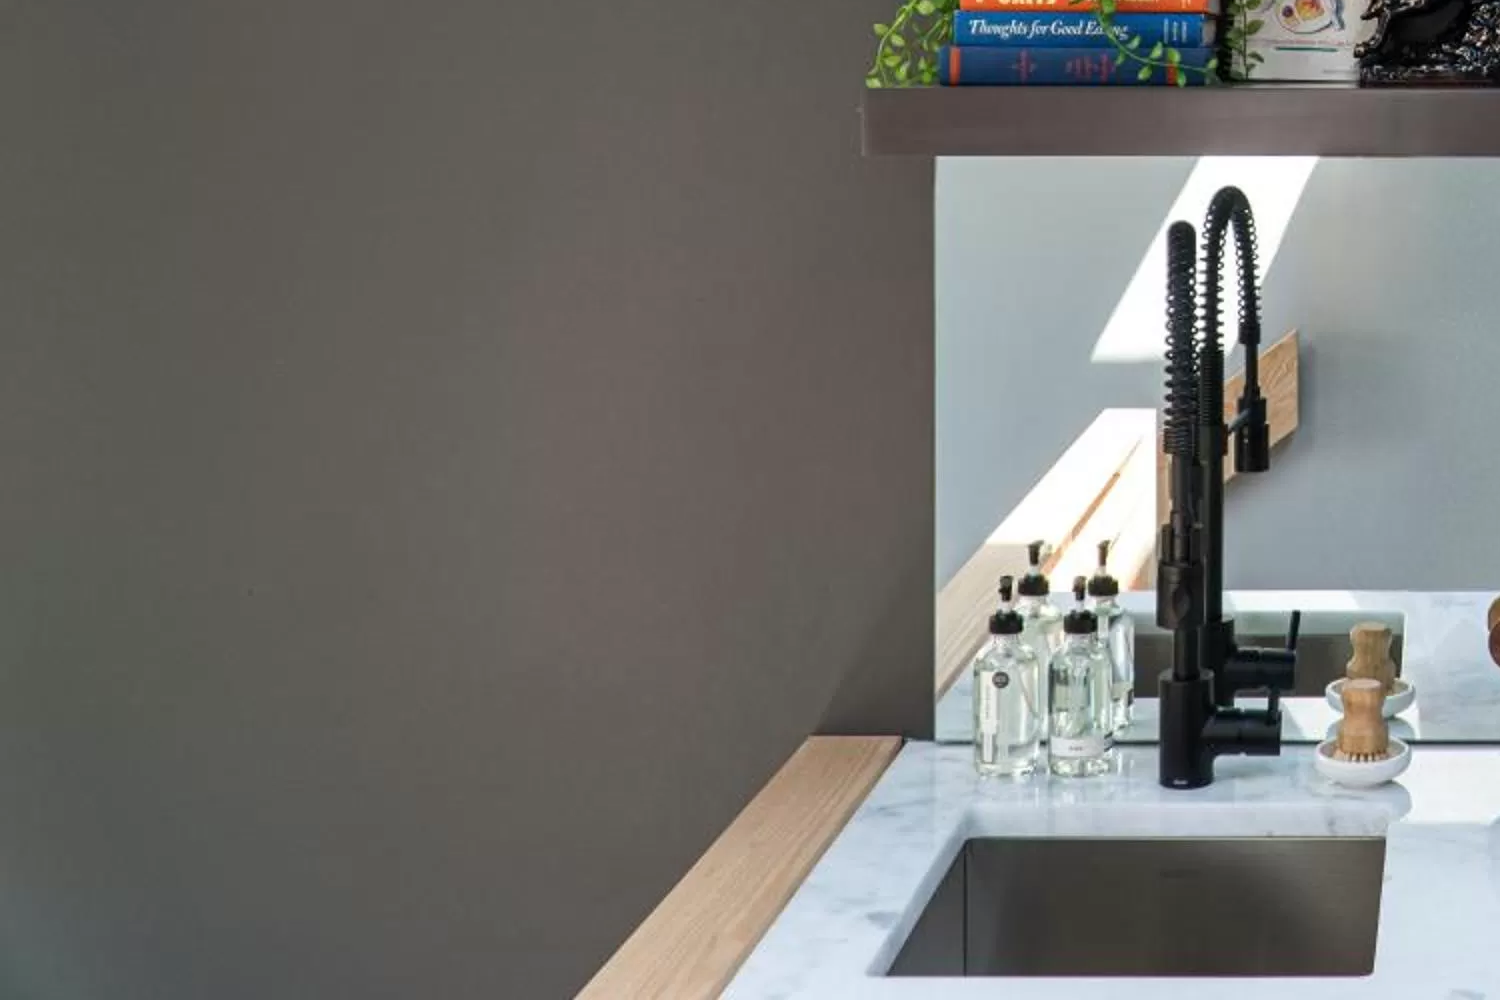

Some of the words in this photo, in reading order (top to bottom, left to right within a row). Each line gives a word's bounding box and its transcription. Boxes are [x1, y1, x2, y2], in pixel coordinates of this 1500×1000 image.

[968, 18, 1027, 39] Thoughts
[1027, 19, 1048, 39] for
[1050, 18, 1082, 36] Good
